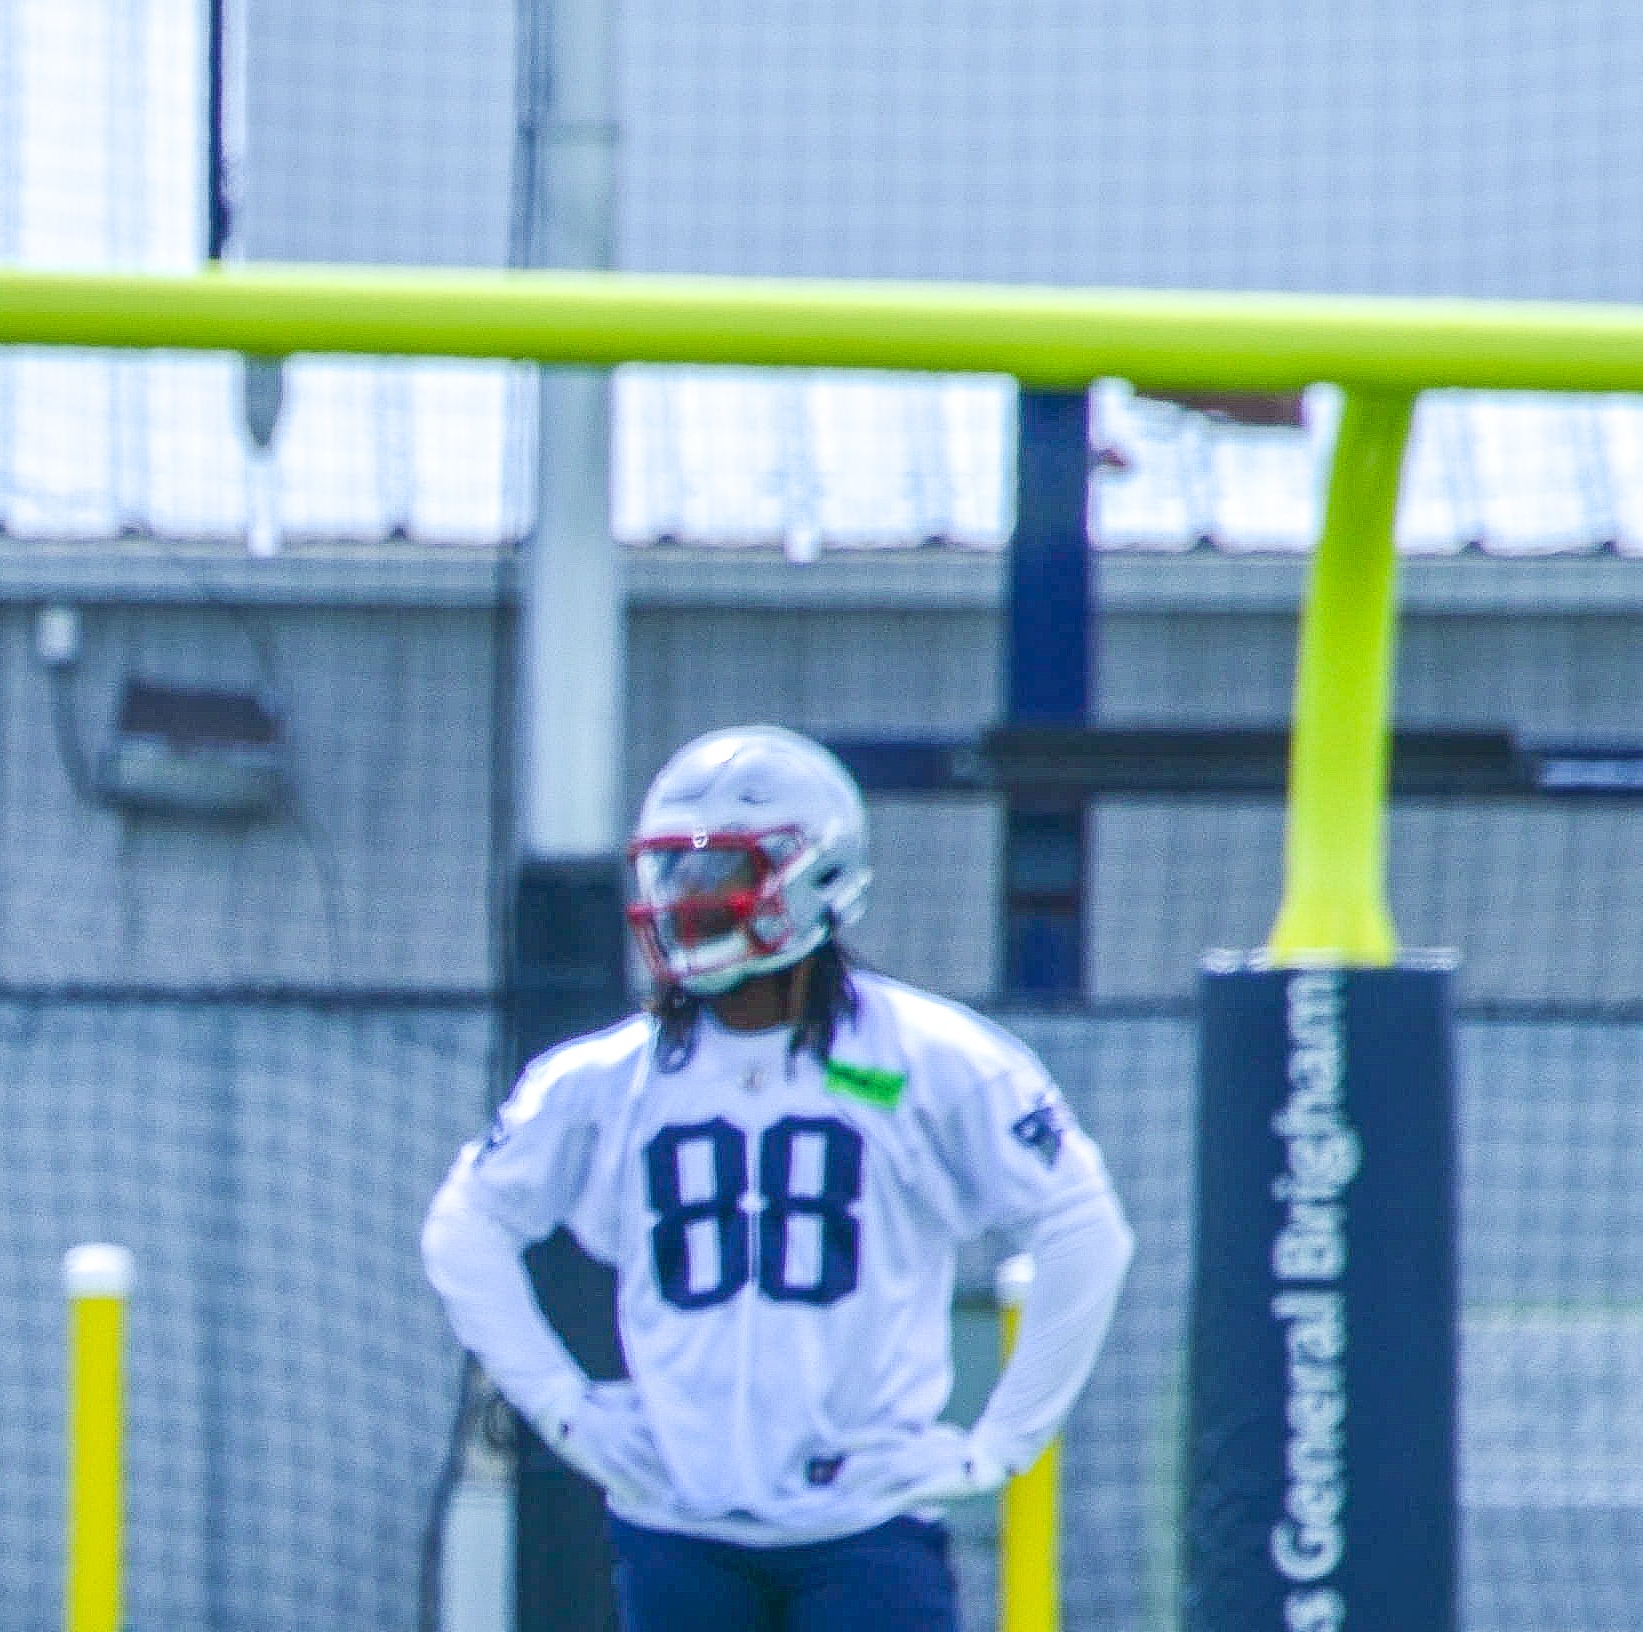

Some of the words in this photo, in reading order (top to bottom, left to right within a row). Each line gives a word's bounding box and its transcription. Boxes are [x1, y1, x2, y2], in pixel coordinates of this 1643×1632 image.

[642, 1113, 866, 1310] 88
[1268, 972, 1365, 1281] Brigham
[1269, 1291, 1350, 1582] General
